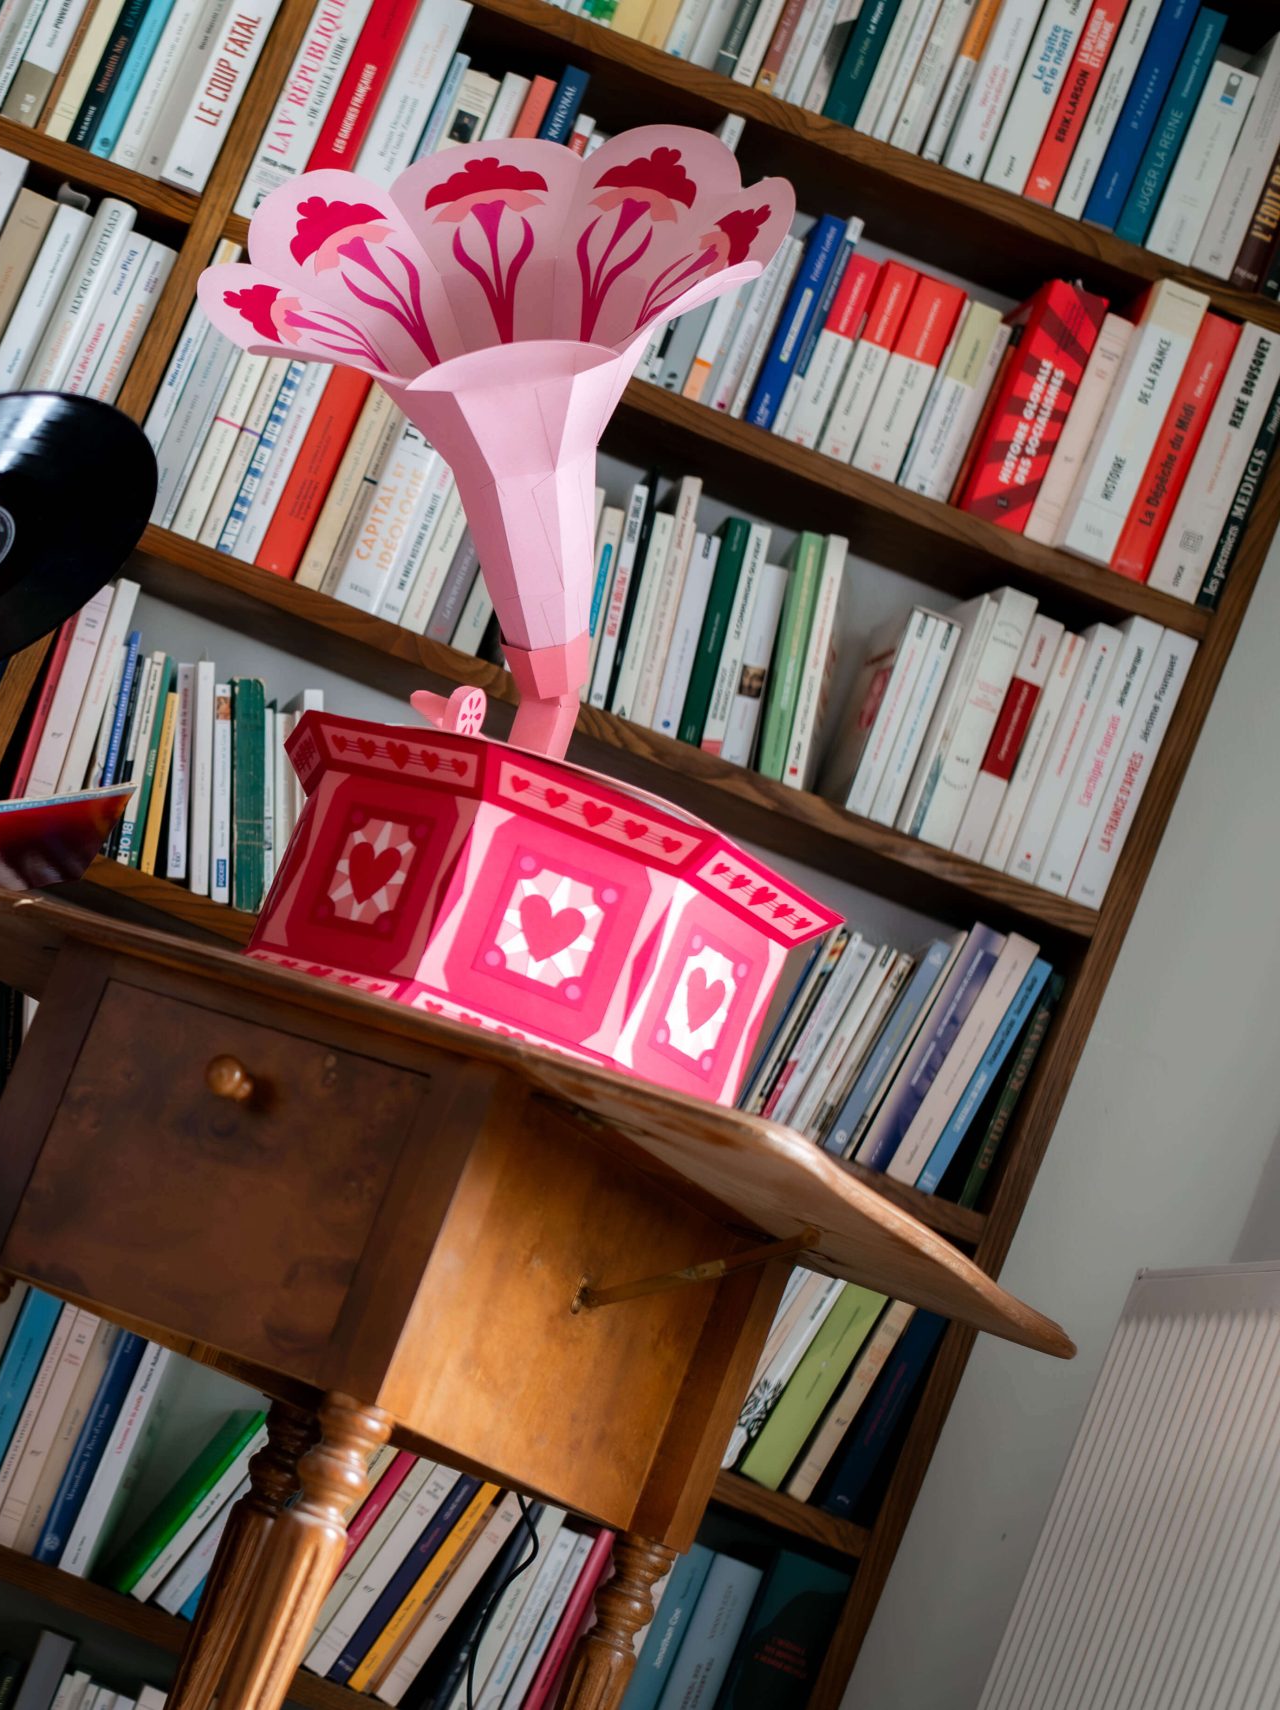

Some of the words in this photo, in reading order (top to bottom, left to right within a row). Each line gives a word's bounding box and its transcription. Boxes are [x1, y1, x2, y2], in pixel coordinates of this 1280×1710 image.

[223, 8, 262, 60] FATAL
[866, 23, 877, 35] Le
[1039, 23, 1063, 62] traître
[1051, 26, 1074, 65] néant
[1082, 7, 1108, 53] SPLENDEUR
[94, 52, 119, 93] Meredith
[111, 32, 128, 54] May
[329, 32, 351, 66] CHIRAC
[1078, 51, 1090, 65] LA
[204, 57, 241, 104] COUP
[311, 71, 334, 107] GAULLE
[350, 61, 380, 109] FRANÇAISES
[1032, 62, 1047, 80] Le
[1039, 78, 1053, 96] et
[1045, 64, 1059, 80] le
[75, 104, 97, 142] MAZARINE
[194, 100, 222, 128] LE
[306, 104, 320, 119] DE
[338, 104, 361, 139] GAUCHES
[547, 83, 578, 140] NATIONAL
[1055, 115, 1073, 143] ERIK
[1066, 69, 1091, 116] LARSON
[331, 135, 348, 154] LES
[1159, 107, 1185, 150] REINE
[1152, 148, 1168, 169] LA
[1133, 167, 1161, 214] JUGER
[119, 246, 139, 272] Picq
[809, 250, 828, 282] Frédéric
[76, 321, 107, 374] Lévi-Strauss
[166, 368, 180, 387] Médias
[177, 336, 194, 363] Territoires
[1148, 336, 1172, 376] FRANCE
[856, 370, 866, 381] de
[896, 387, 906, 399] de
[1143, 374, 1157, 390] LA
[1227, 395, 1250, 429] RENÉ
[1241, 337, 1273, 396] BOUSQUET
[1137, 388, 1152, 405] DE
[997, 419, 1030, 483] HISTOIRE
[1021, 358, 1054, 421] GLOBALE
[1013, 457, 1032, 485] DES
[1024, 367, 1067, 457] SOCIALISMES
[1175, 401, 1197, 432] Midi
[1168, 430, 1185, 451] du
[1100, 454, 1127, 501] HISTOIRE
[1146, 450, 1179, 509] Dépêche
[1232, 446, 1269, 521] MEDICIS
[354, 480, 398, 562] CAPITAL
[373, 467, 428, 572] IDÉOLOGIE
[421, 522, 430, 532] DE
[423, 492, 442, 524] L'ÉGALITÉ
[1138, 506, 1155, 527] La
[410, 530, 427, 559] HISTOIRE
[1210, 522, 1243, 579] premiers
[397, 577, 408, 591] UNE
[401, 557, 416, 578] BRÈVE
[1203, 575, 1221, 596] les
[1114, 678, 1131, 708] Jérôme
[1125, 645, 1145, 680] Fourquet
[114, 690, 128, 729] MAINTENANT
[1137, 702, 1161, 743] Jérôme
[1153, 652, 1181, 704] Fourquet
[107, 751, 116, 767] NOUS
[110, 728, 121, 752] SOMMES
[1076, 755, 1107, 809] L'archipel
[1096, 712, 1123, 759] français
[1118, 749, 1146, 797] D'APRÈS
[1102, 793, 1129, 839] FRANCE
[1097, 835, 1113, 853] LA
[651, 1625, 677, 1668] Jonathan
[669, 1606, 685, 1627] Coe
